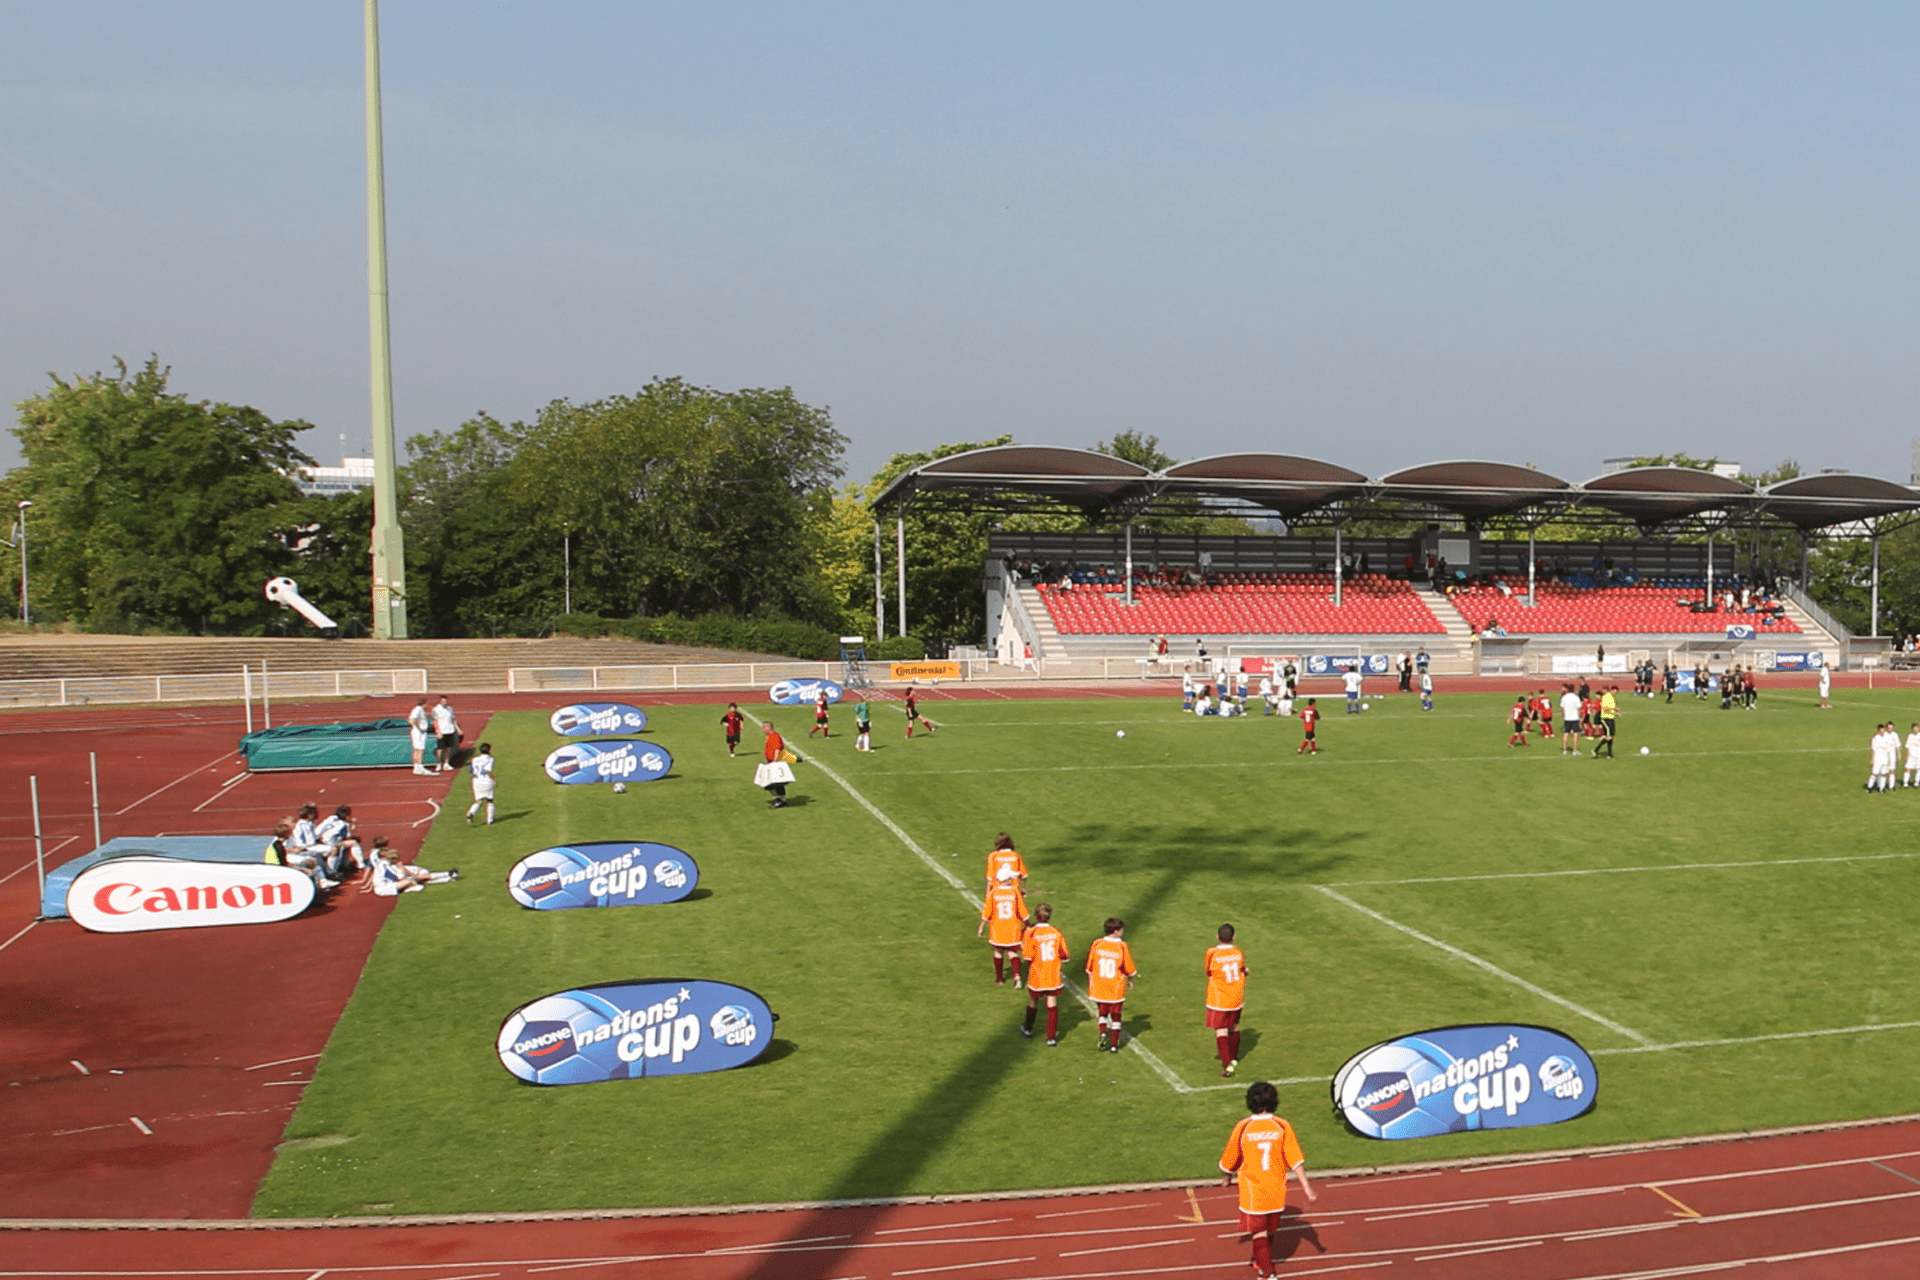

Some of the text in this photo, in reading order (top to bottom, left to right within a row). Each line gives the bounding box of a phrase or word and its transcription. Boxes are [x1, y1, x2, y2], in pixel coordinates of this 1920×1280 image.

[896, 665, 946, 677] Continental
[591, 713, 622, 731] cup
[579, 747, 628, 769] nations
[597, 754, 637, 777] cup
[562, 853, 633, 886] nations
[589, 864, 648, 898] cup
[664, 872, 687, 888] cup
[93, 882, 292, 915] Canon
[996, 901, 1013, 919] 13
[1040, 940, 1056, 962] 16
[1098, 957, 1117, 979] 10
[1221, 961, 1240, 983] 11
[576, 997, 680, 1047] nations
[513, 1027, 572, 1055] DANONE
[617, 1013, 701, 1063] cup
[726, 1024, 757, 1046] cup
[1414, 1043, 1509, 1100] nations
[1356, 1078, 1412, 1109] DANONE
[1453, 1062, 1531, 1116] cup
[1555, 1076, 1583, 1100] cup
[1257, 1142, 1272, 1172] 7
